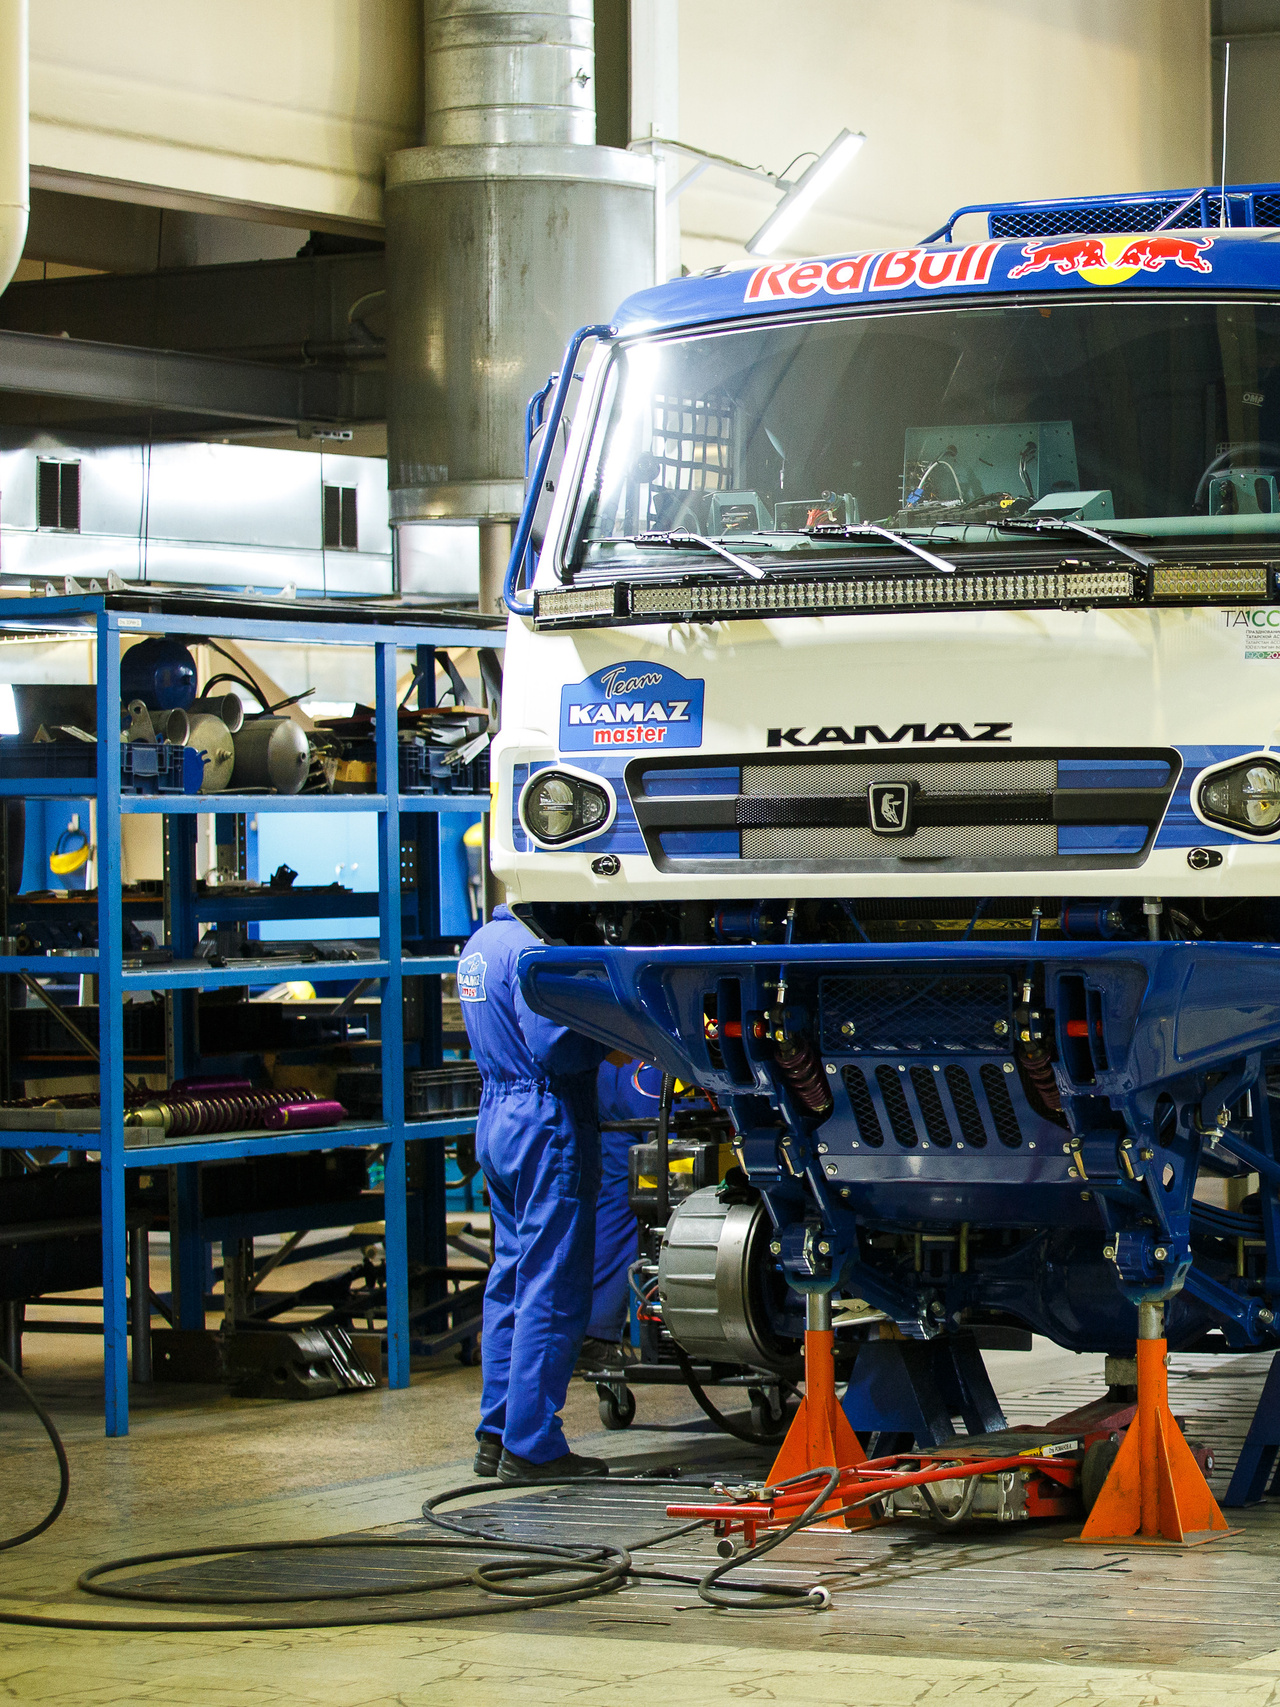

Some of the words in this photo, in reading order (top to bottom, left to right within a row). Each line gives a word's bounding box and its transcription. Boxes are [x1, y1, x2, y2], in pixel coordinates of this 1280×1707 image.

[747, 252, 877, 301] Red
[871, 242, 1002, 291] Bull
[601, 666, 662, 699] Team
[569, 701, 691, 725] KAMAZ
[594, 725, 667, 744] master
[767, 722, 1013, 748] KAMAZ
